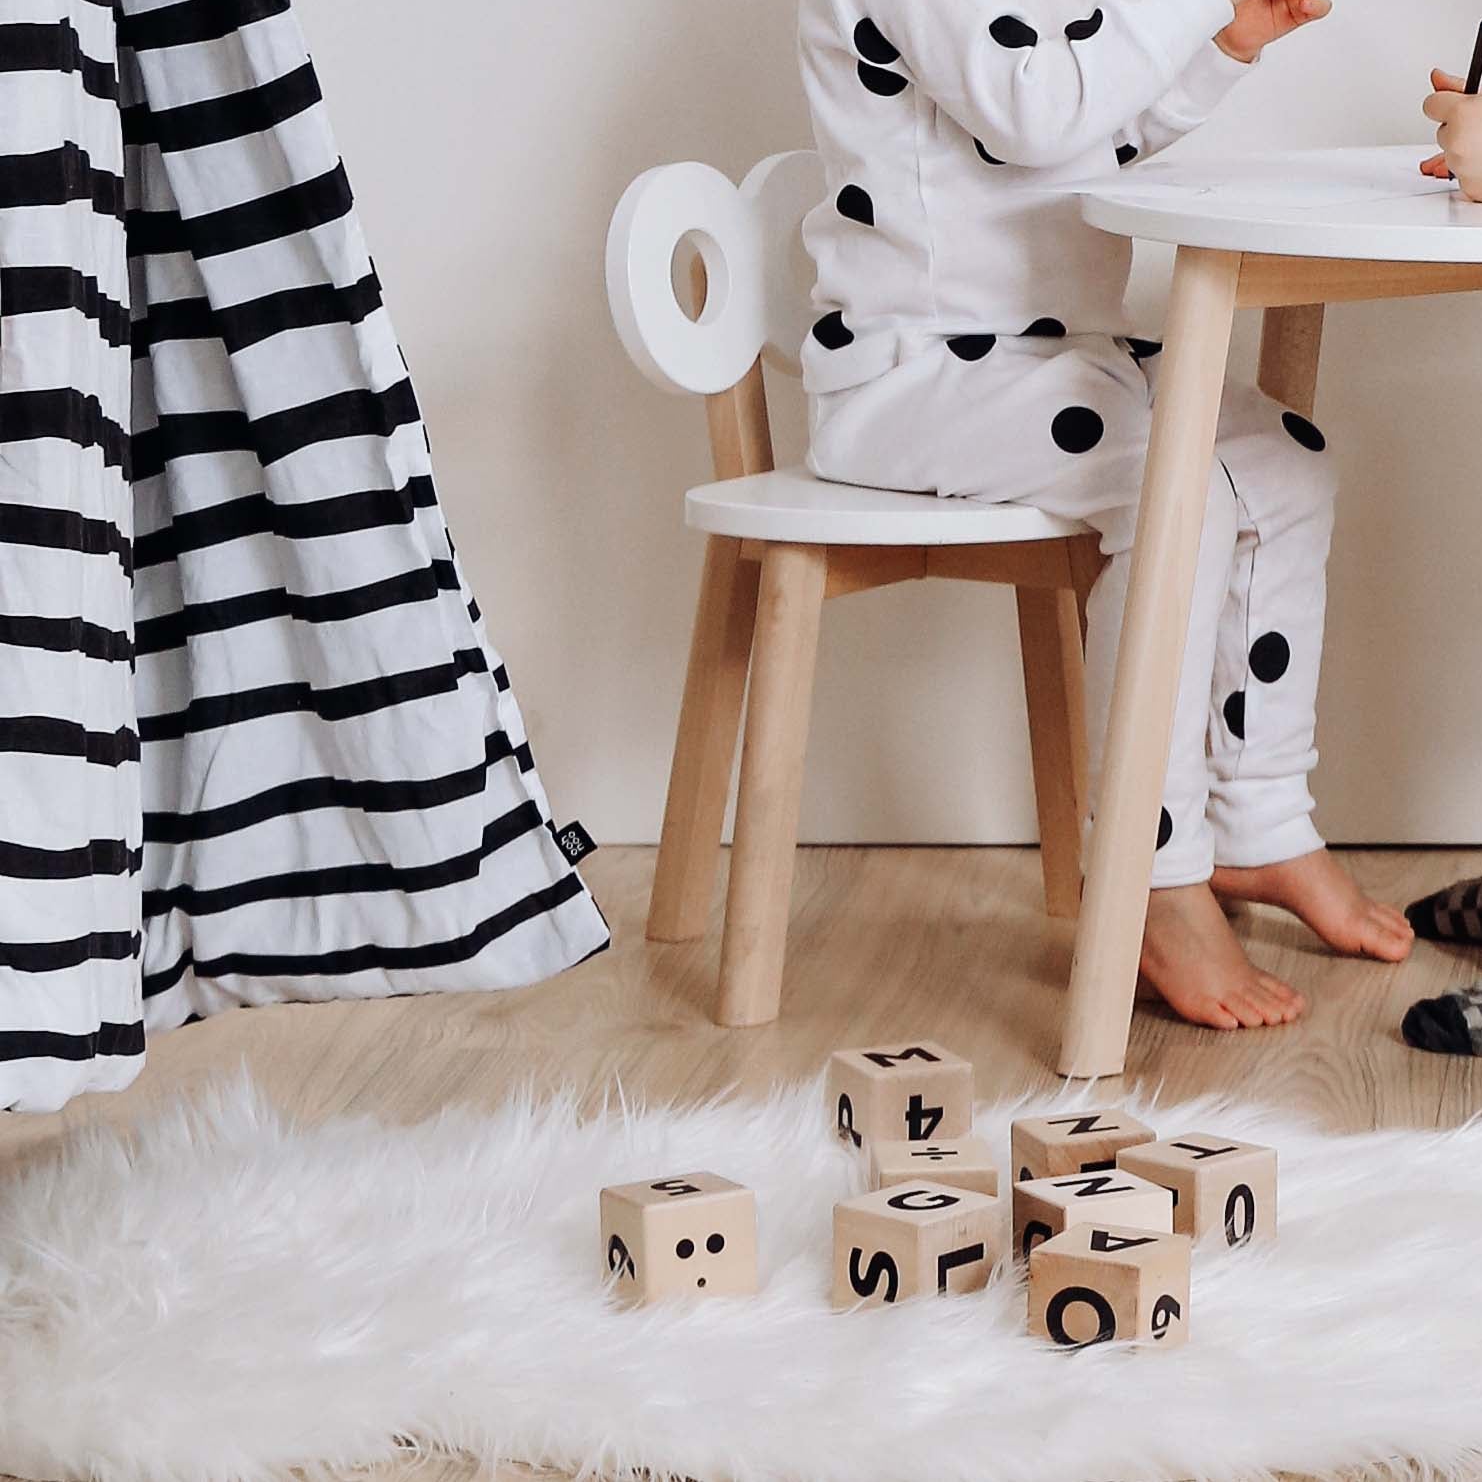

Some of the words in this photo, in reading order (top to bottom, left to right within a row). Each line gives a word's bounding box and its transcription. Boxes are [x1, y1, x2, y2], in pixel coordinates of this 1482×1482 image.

[905, 1094, 943, 1140] 4
[888, 1191, 959, 1210] G
[1091, 1230, 1157, 1252] A
